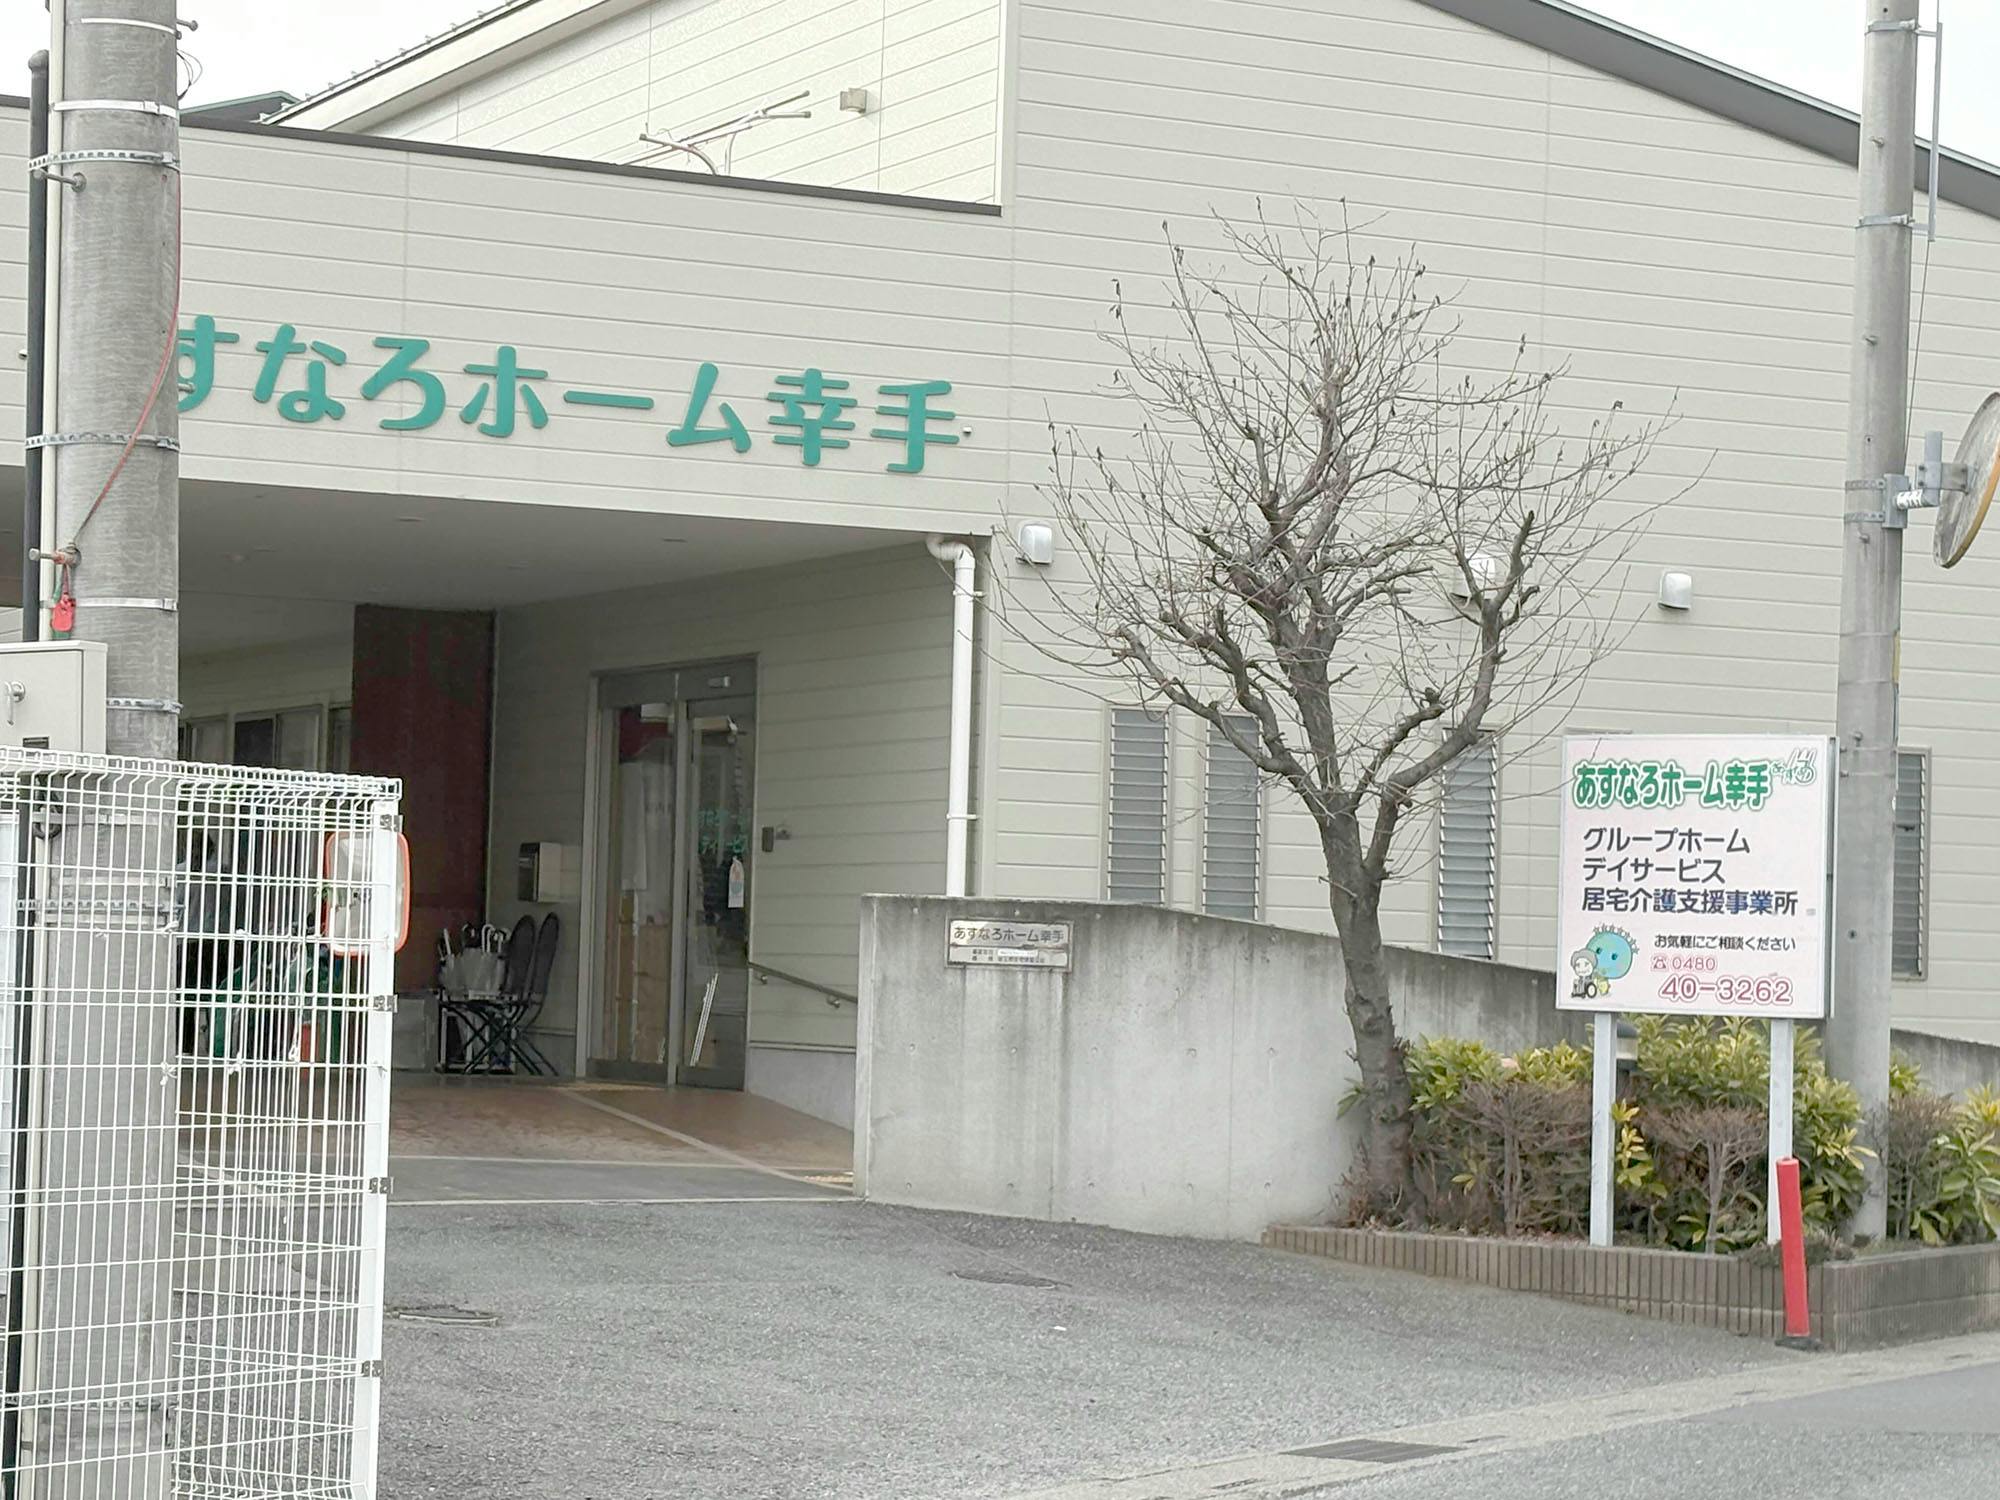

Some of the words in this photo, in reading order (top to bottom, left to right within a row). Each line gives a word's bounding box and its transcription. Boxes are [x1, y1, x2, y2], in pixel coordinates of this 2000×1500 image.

[1575, 762, 1769, 808] あすなろホーム幸手
[1583, 826, 1751, 854] グループホーム
[1583, 856, 1726, 884] デイサービス
[1582, 886, 1799, 916] 居宅介護支援事業所
[953, 926, 1065, 942] あすなろホーム幸手
[1654, 935, 1796, 951] お気軽にご相談ください
[1672, 956, 1716, 971] 0480
